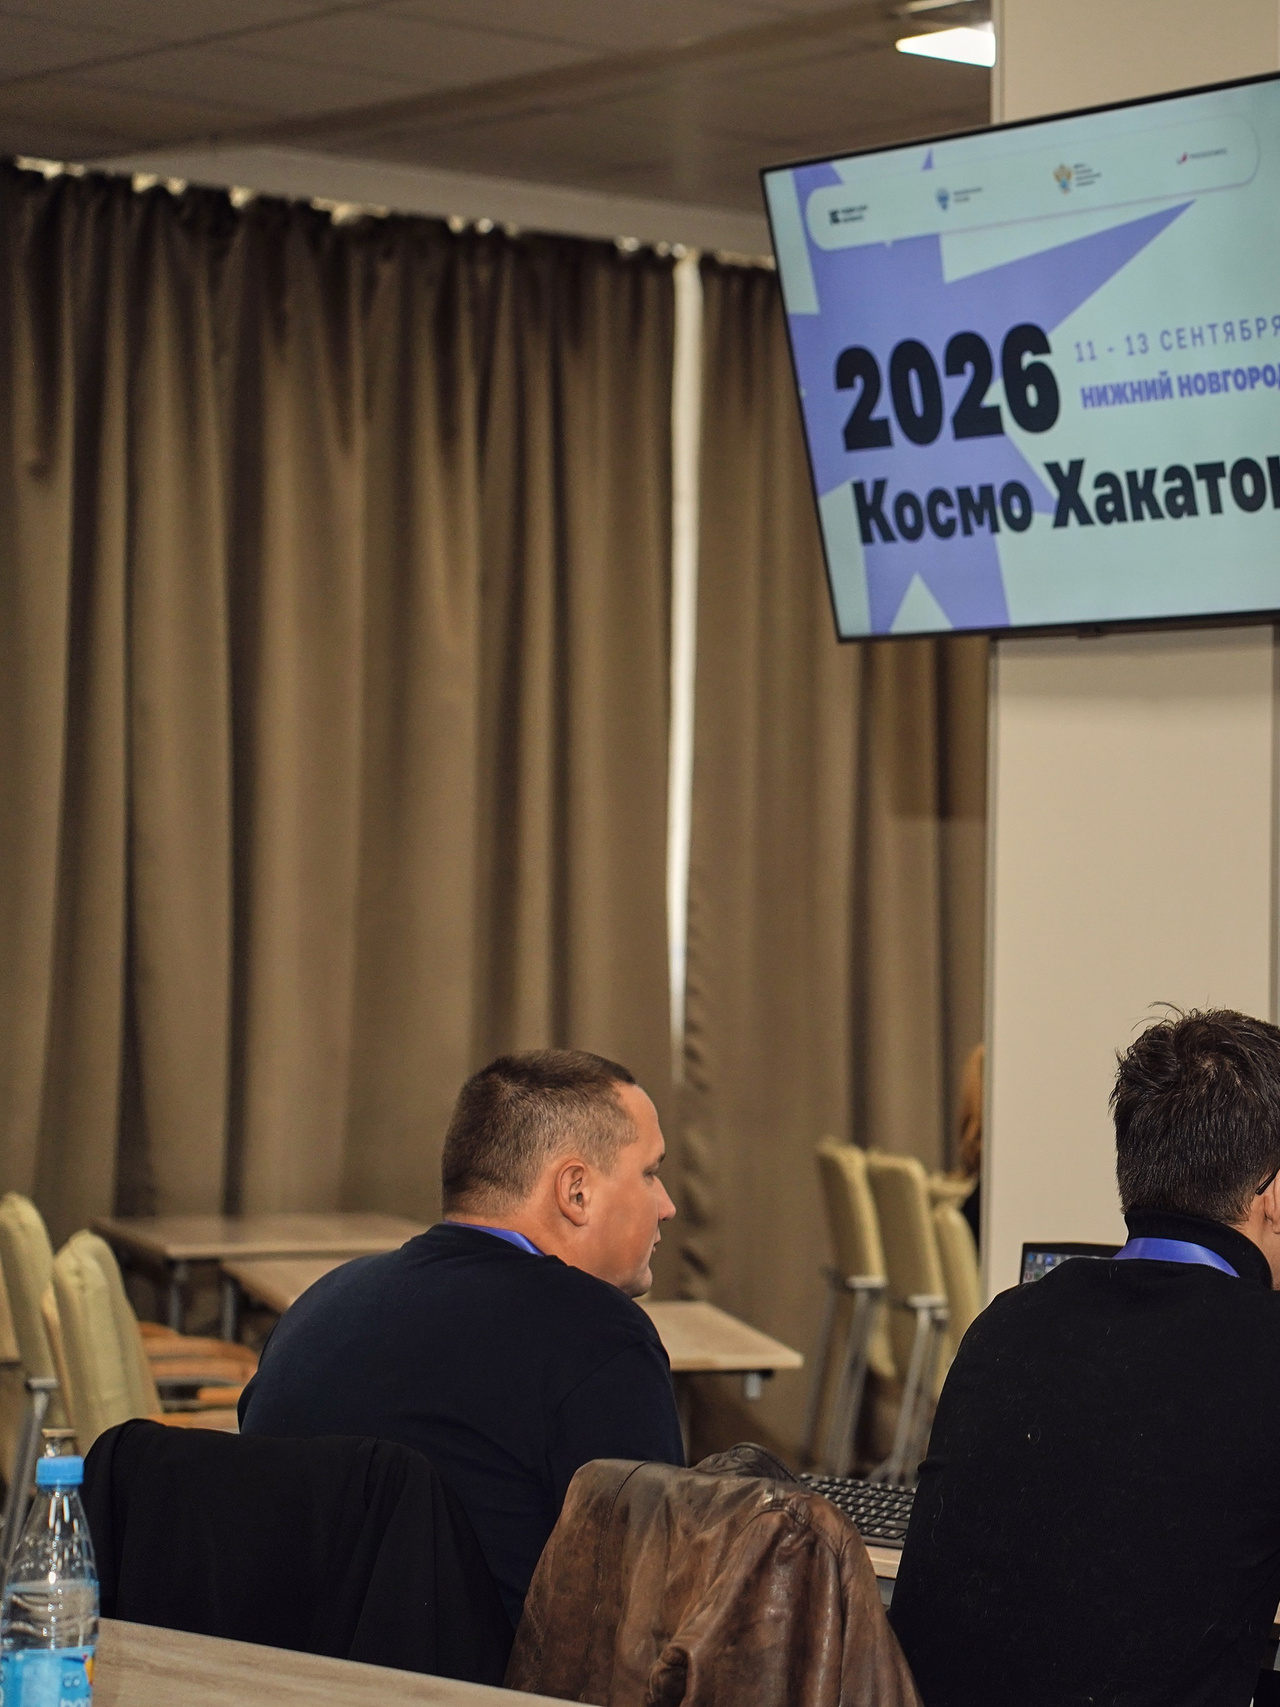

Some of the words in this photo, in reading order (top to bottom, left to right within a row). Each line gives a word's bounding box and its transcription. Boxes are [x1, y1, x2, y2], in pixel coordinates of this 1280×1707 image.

[1074, 340, 1097, 363] 11
[1125, 332, 1150, 356] 13
[835, 321, 1061, 452] 2026
[1080, 370, 1174, 410] НИЖНИЙ
[851, 477, 1034, 546] Космо
